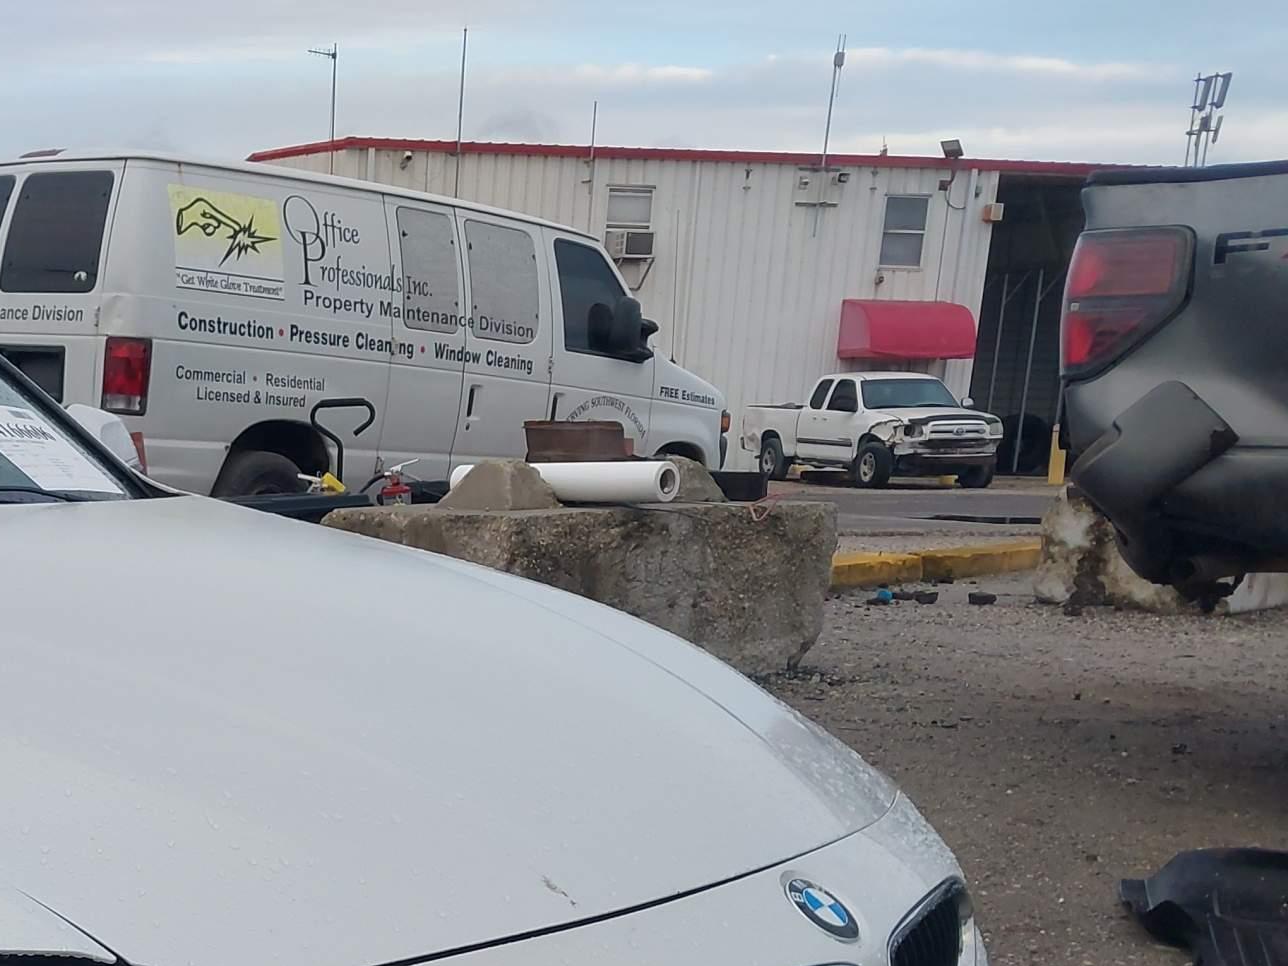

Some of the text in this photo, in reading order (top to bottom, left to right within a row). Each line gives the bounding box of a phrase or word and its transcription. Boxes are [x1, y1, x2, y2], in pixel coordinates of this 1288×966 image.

[283, 195, 360, 248] Office
[296, 230, 433, 297] Professionals Inc.
[31, 305, 83, 321] Division
[304, 289, 374, 319] Property
[478, 315, 534, 338] Division
[178, 311, 274, 339] Construction
[290, 324, 350, 348] Pressure
[434, 342, 481, 364] Window
[486, 350, 534, 375] Cleaning
[176, 365, 325, 391] Commercial Residential
[197, 387, 306, 408] Licensed & Insured
[659, 386, 715, 405] FREE Estimates
[624, 406, 646, 438] FLORIDA
